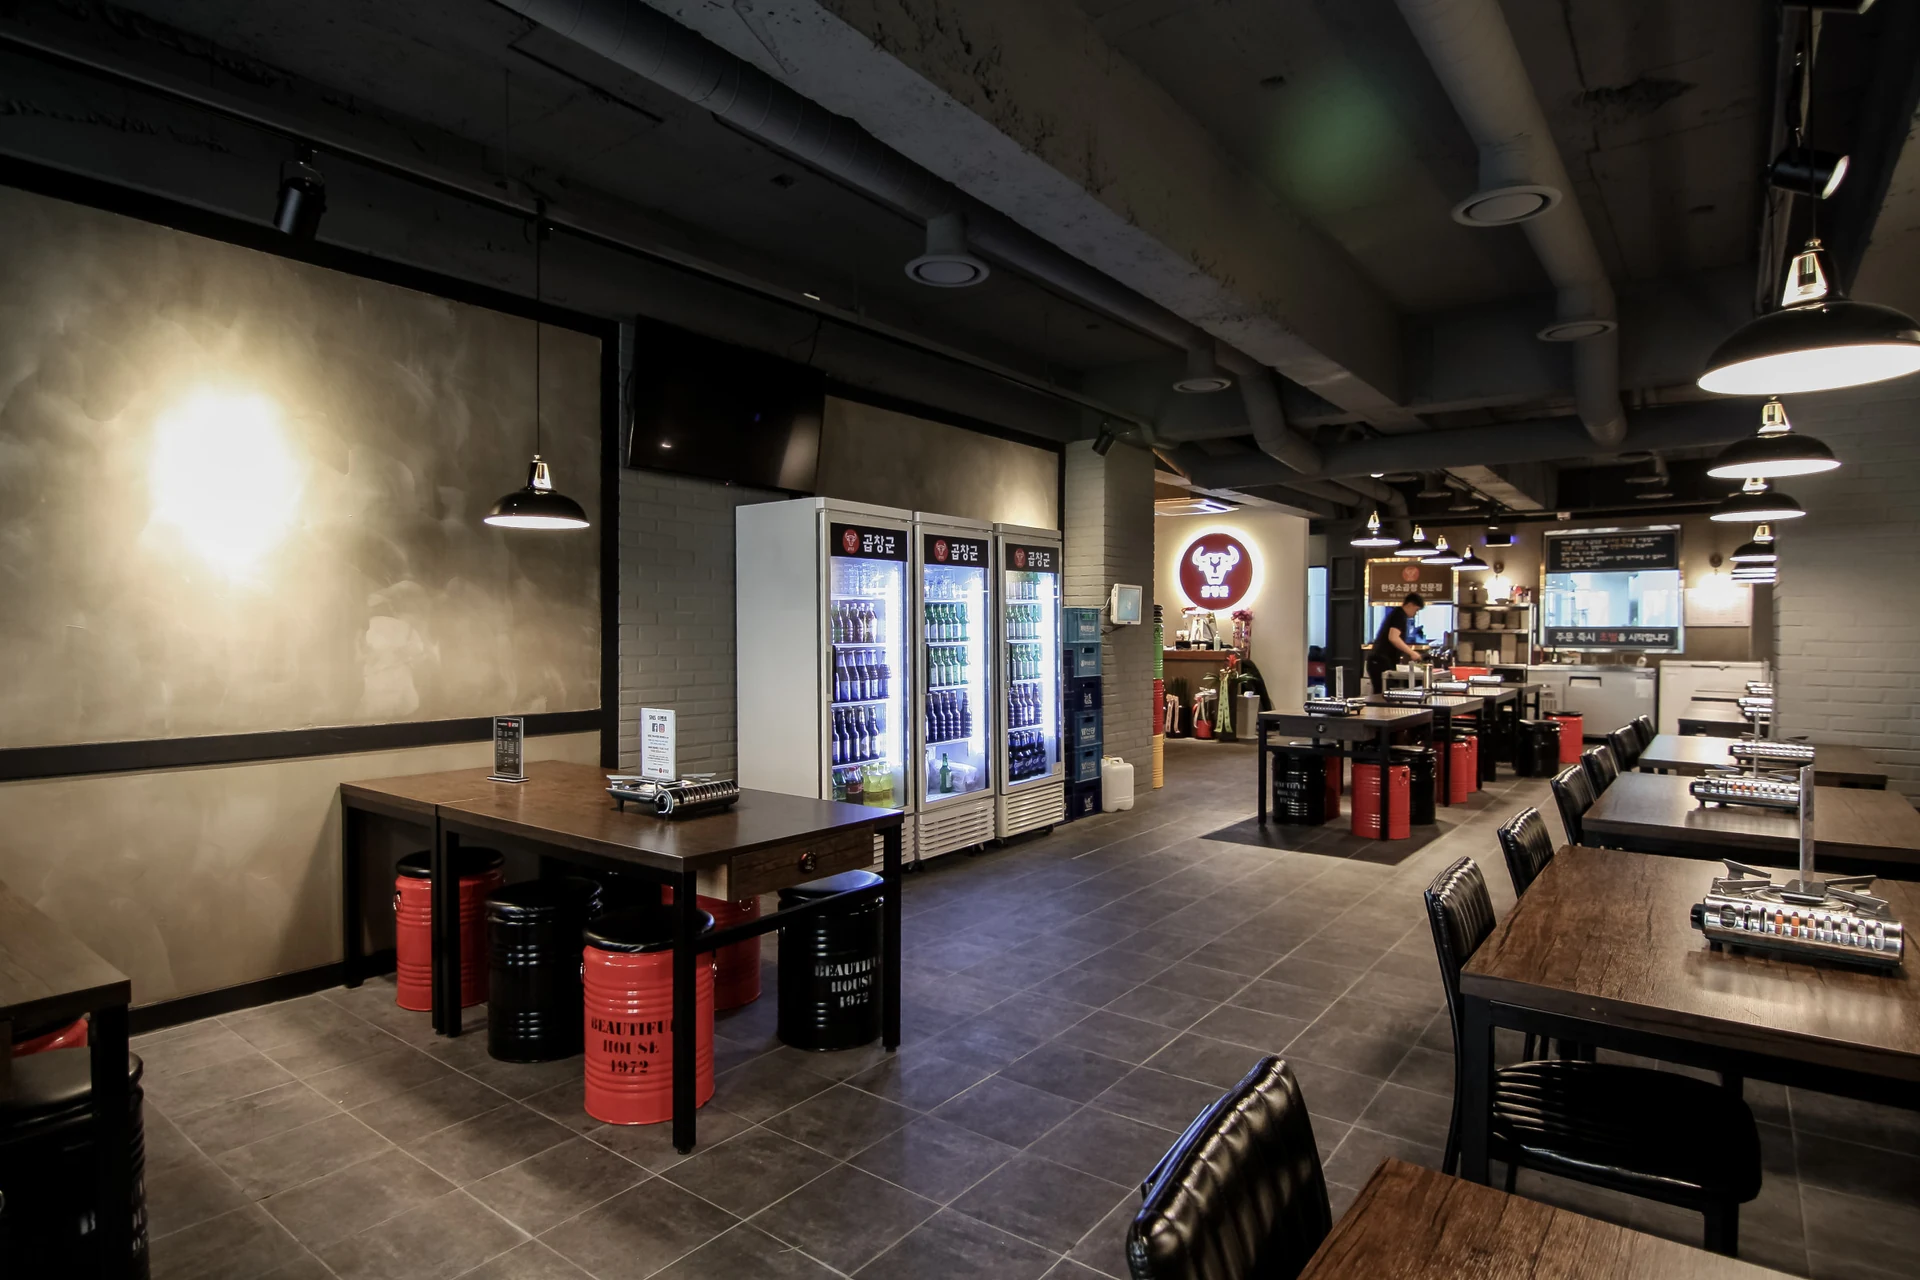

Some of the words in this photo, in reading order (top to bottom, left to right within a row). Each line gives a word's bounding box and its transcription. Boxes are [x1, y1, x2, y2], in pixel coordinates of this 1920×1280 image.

[862, 533, 895, 554] 곱창군
[950, 544, 978, 561] 곱창군
[1027, 551, 1050, 567] 곱창군
[840, 991, 869, 1008] 1972
[603, 1040, 660, 1054] HOUSE
[611, 1059, 649, 1074] 1972
